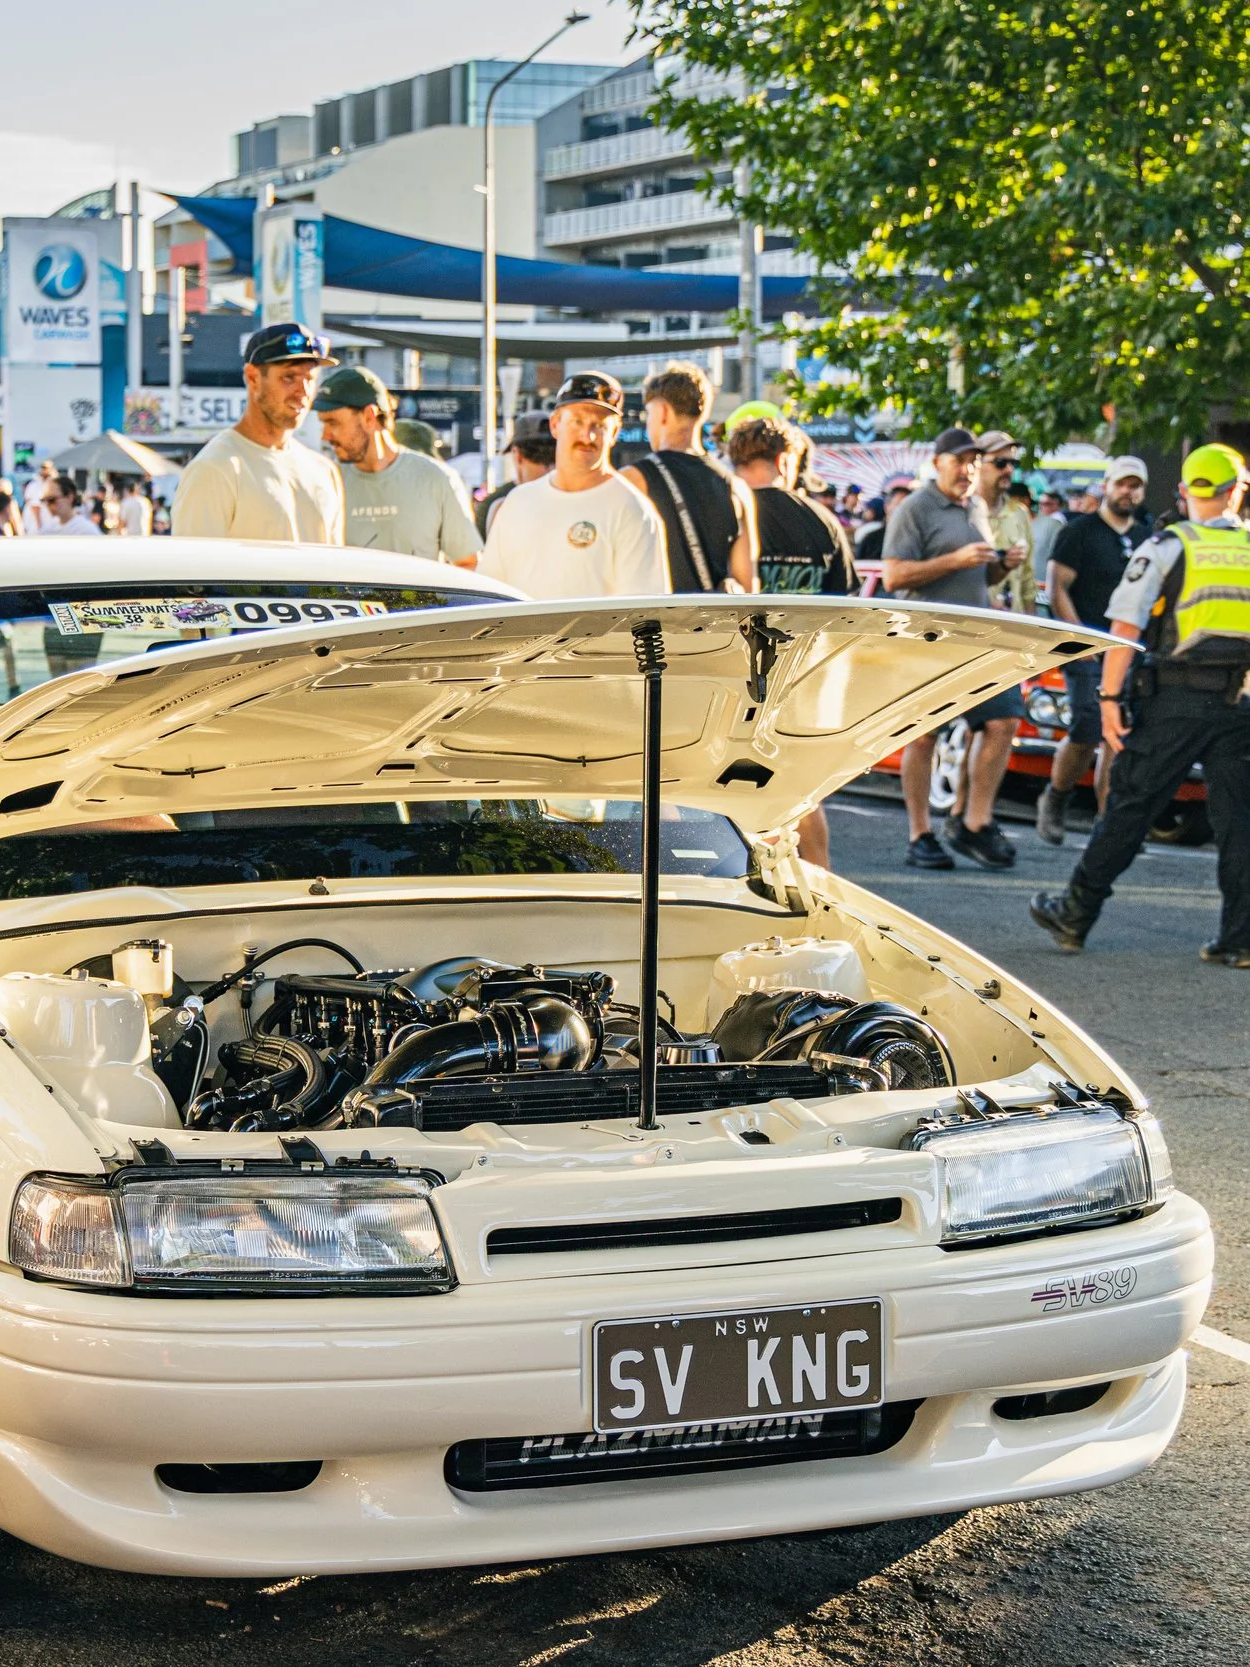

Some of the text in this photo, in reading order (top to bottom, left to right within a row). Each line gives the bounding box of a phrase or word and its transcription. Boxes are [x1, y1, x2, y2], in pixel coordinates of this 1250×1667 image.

[19, 304, 90, 327] WAVES
[351, 506, 398, 517] AFENDS
[1196, 553, 1250, 566] POLIC
[81, 604, 180, 617] SUMMERNATS
[125, 614, 145, 624] 38
[1040, 1264, 1138, 1312] SV89
[715, 1317, 769, 1337] NSW
[610, 1329, 871, 1420] SV KNG
